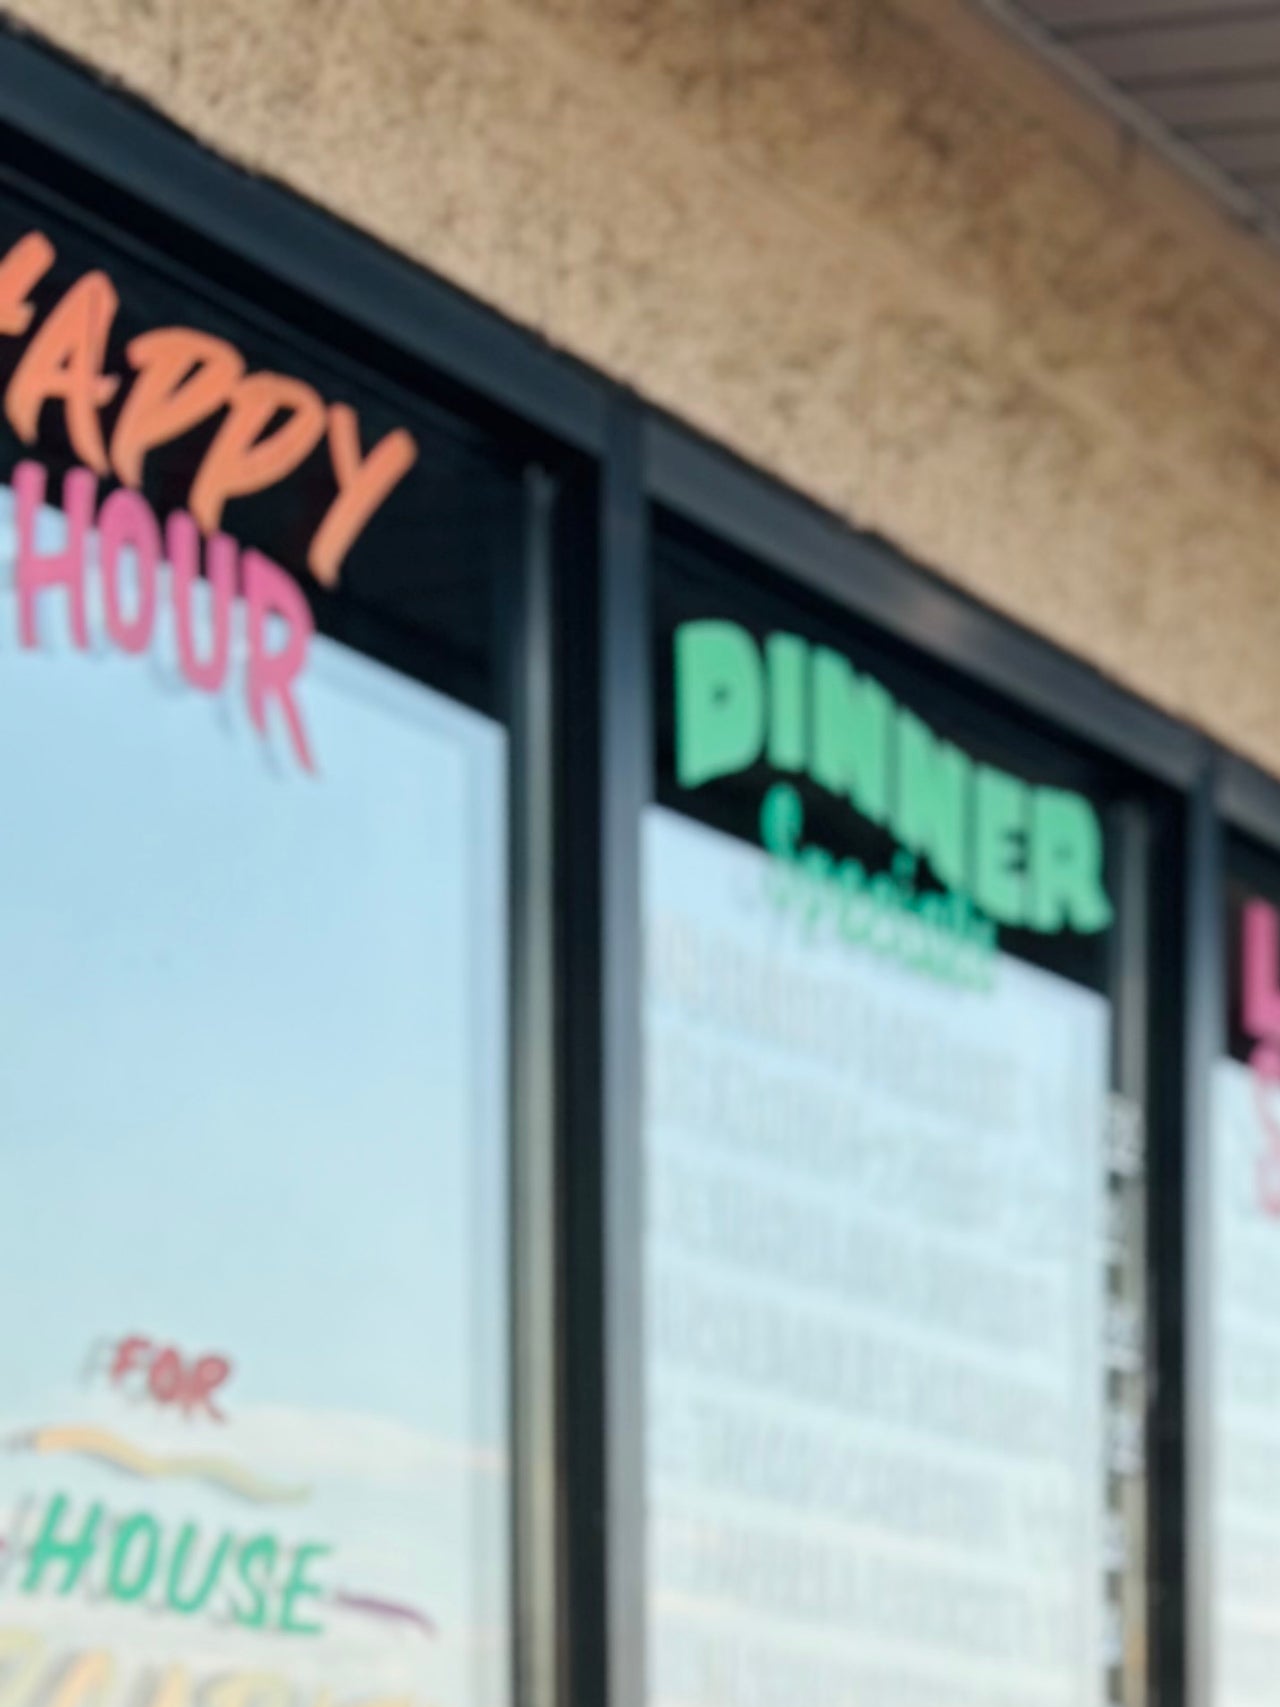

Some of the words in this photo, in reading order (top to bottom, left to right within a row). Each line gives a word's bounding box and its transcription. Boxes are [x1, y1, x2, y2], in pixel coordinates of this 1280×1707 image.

[12, 460, 320, 777] HOUR
[674, 618, 1113, 935] DINNER
[110, 1336, 232, 1424] FOR
[20, 1493, 334, 1635] HOUSE
